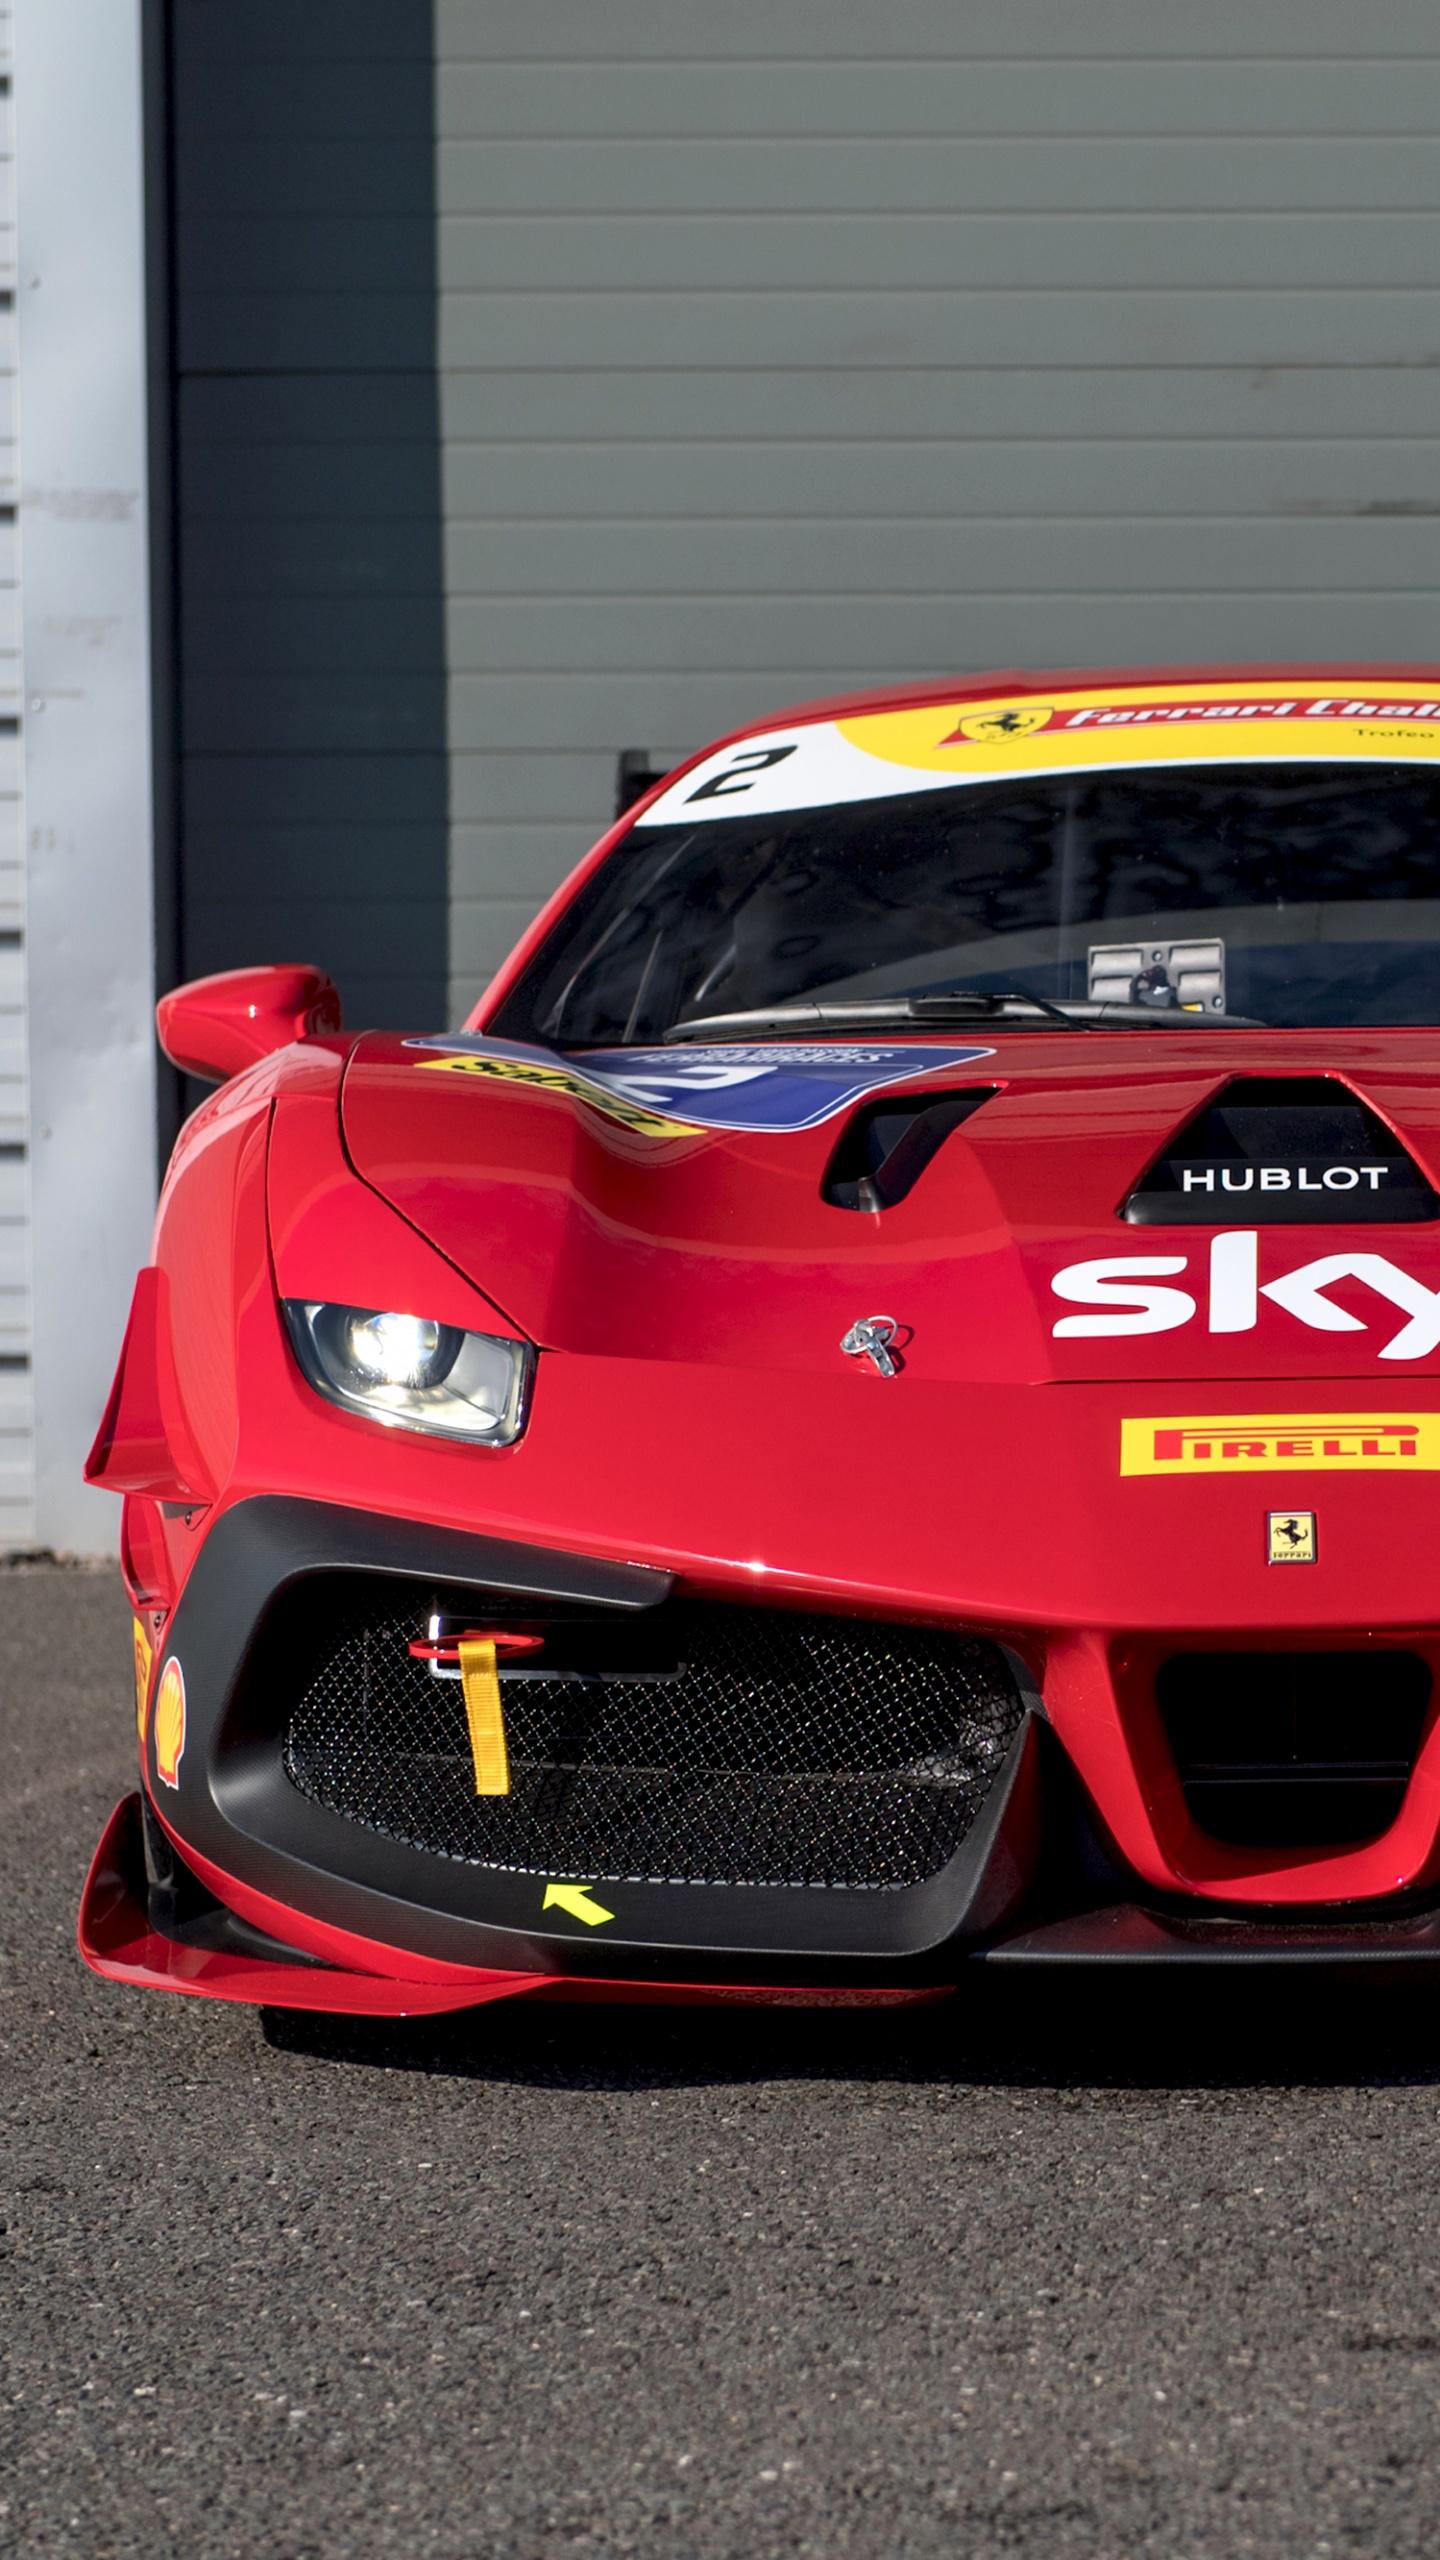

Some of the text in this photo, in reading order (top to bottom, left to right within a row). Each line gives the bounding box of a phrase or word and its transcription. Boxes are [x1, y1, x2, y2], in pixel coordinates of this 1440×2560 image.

[1065, 699, 1440, 728] Ferrari Chal
[1355, 727, 1435, 740] Trofeo
[683, 744, 799, 805] 2
[1182, 1166, 1389, 1193] HUBLOT
[1153, 1425, 1420, 1461] PIRELLI
